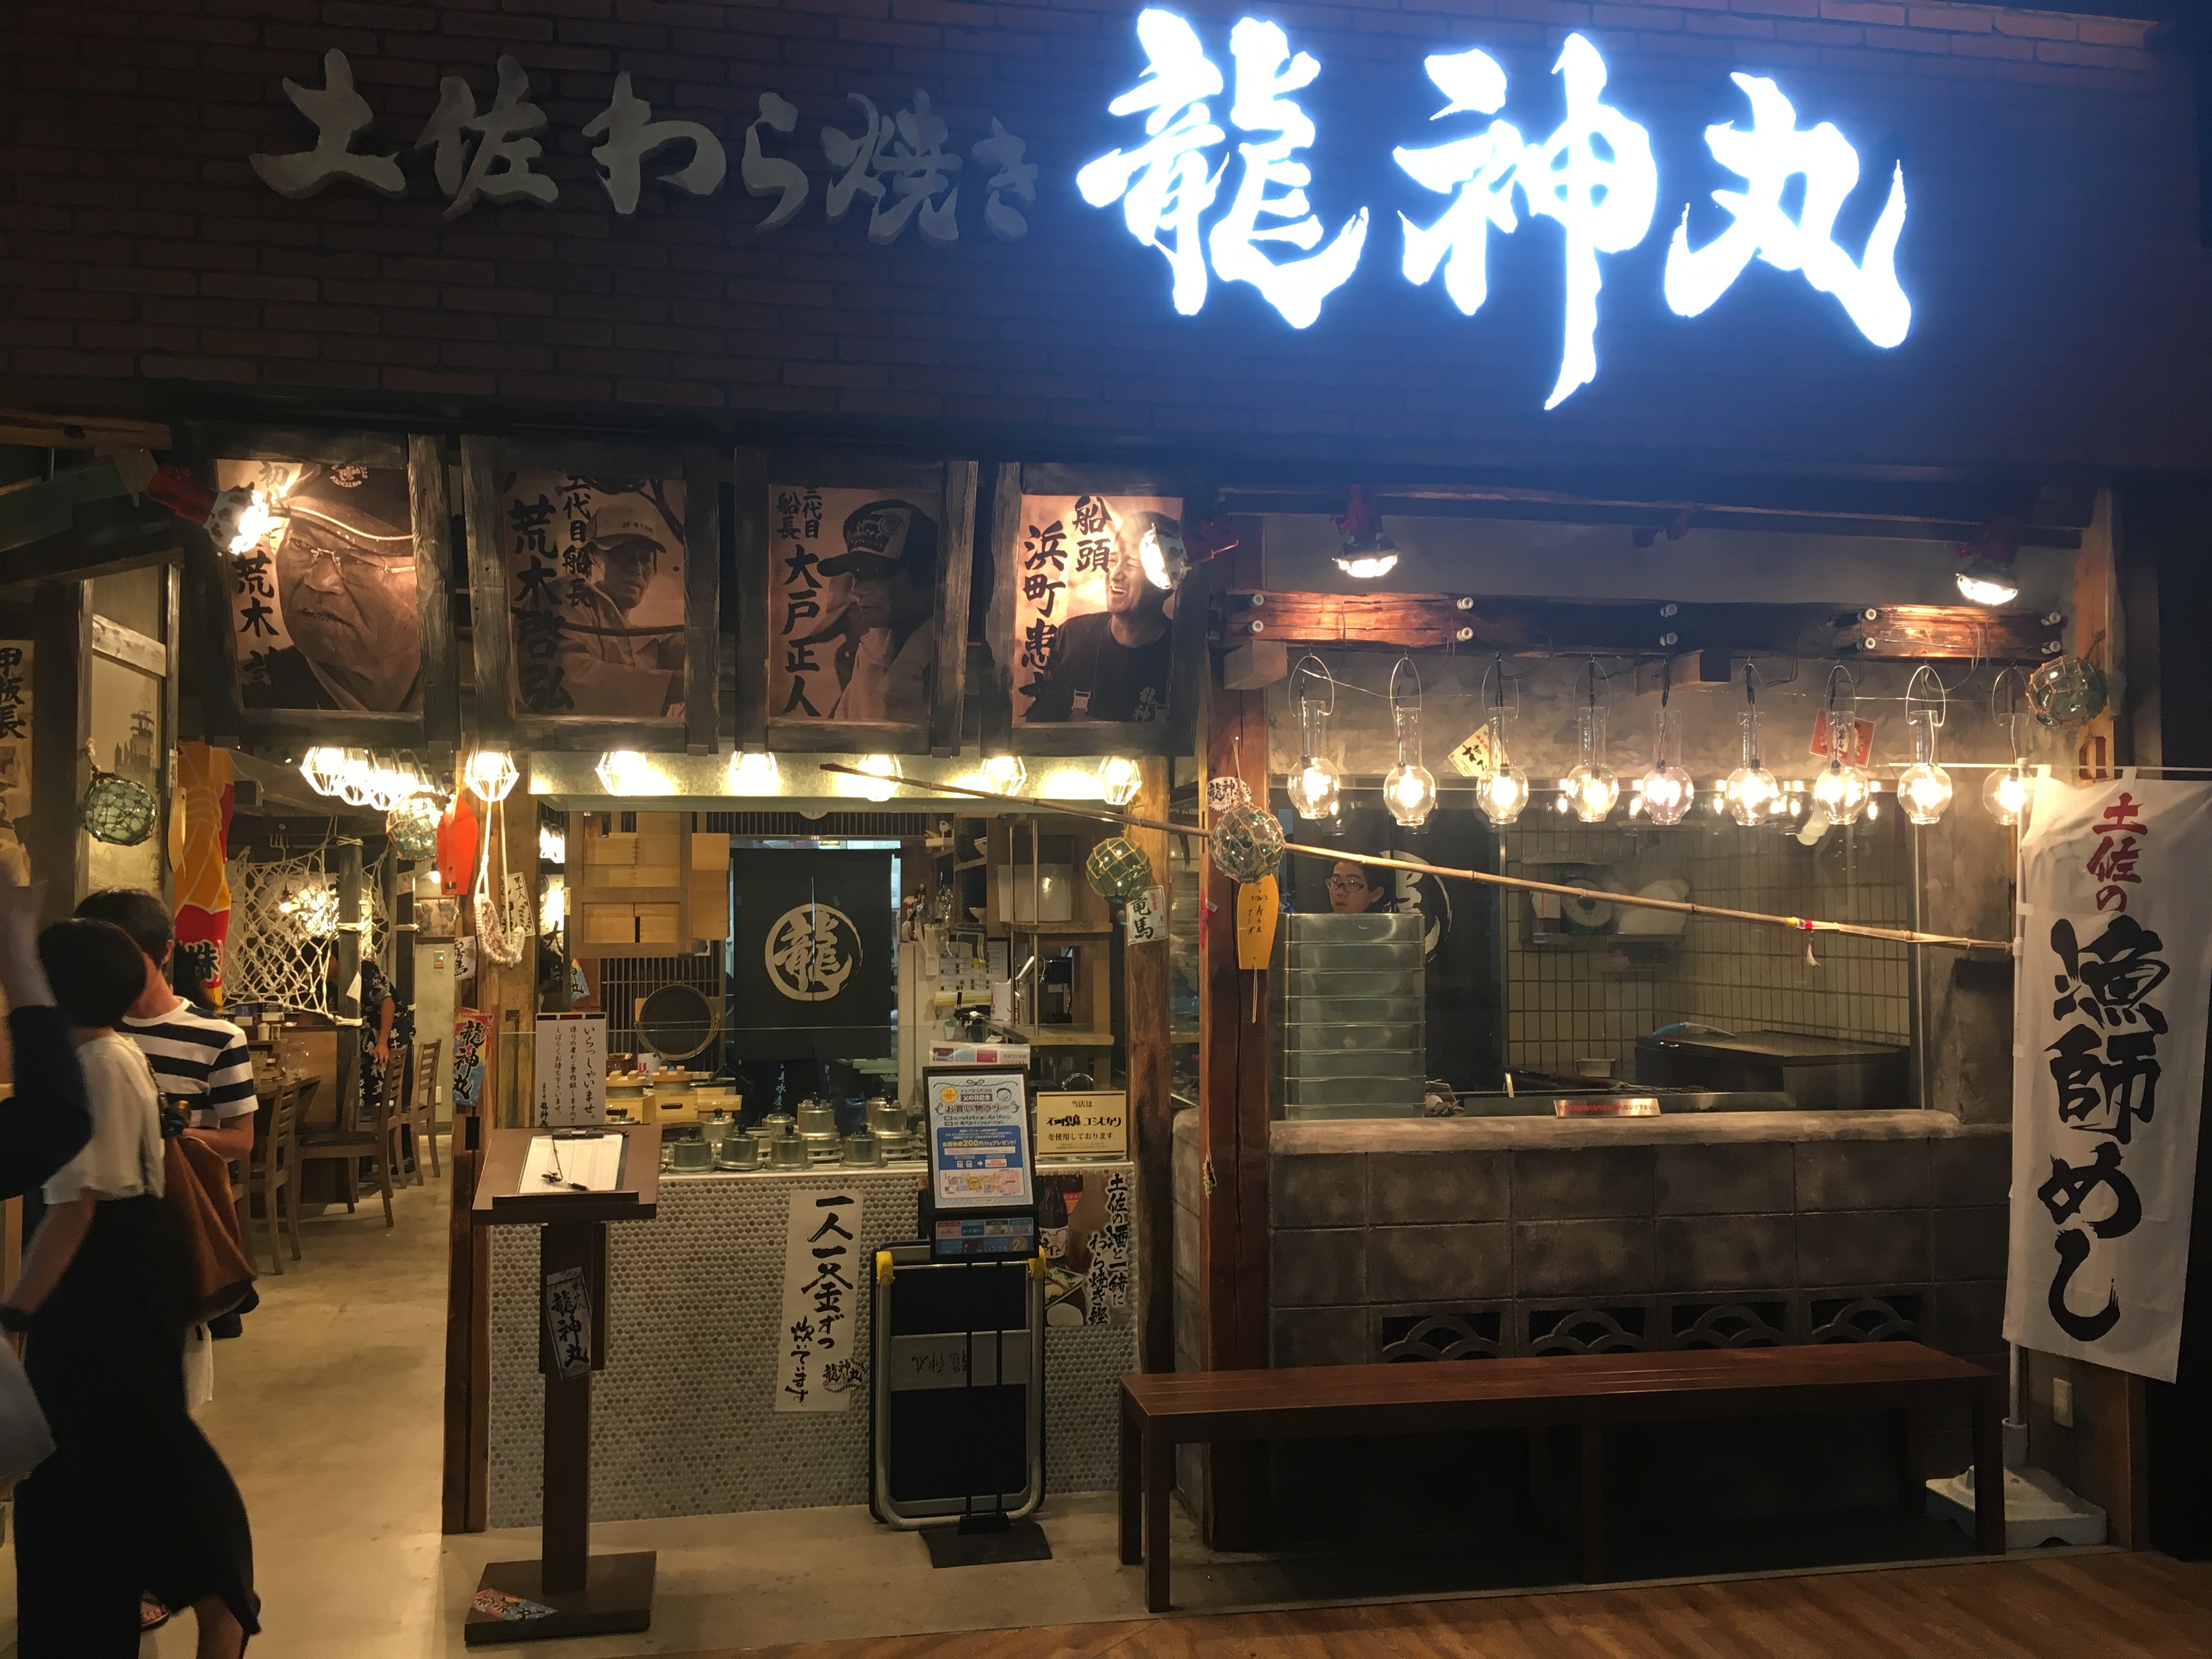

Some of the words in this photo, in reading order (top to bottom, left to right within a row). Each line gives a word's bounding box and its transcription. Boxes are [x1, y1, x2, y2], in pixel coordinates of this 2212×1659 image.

[250, 48, 1038, 245] 土佐わら焼き
[1075, 7, 1912, 410] 龍神丸
[776, 492, 801, 540] 船長
[1072, 495, 1113, 572] 船頭
[781, 544, 823, 717] 大戸正人
[2086, 792, 2147, 912] 土佐の
[773, 910, 852, 992] 龍
[453, 1020, 486, 1100] 龍神丸
[946, 1104, 1011, 1113] お買い物ラリー
[1048, 1132, 1116, 1141] を使用しております。
[1084, 1116, 1121, 1127] コシヒカリ
[2038, 915, 2170, 1342] 漁師めし
[800, 1195, 855, 1349] 一人一釜ずつ
[1088, 1233, 1108, 1325] わら焼き鰹
[1106, 1173, 1128, 1306] 土佐の酒と一緒に
[551, 1290, 590, 1367] 龍神丸
[823, 1358, 863, 1383] 龍神丸
